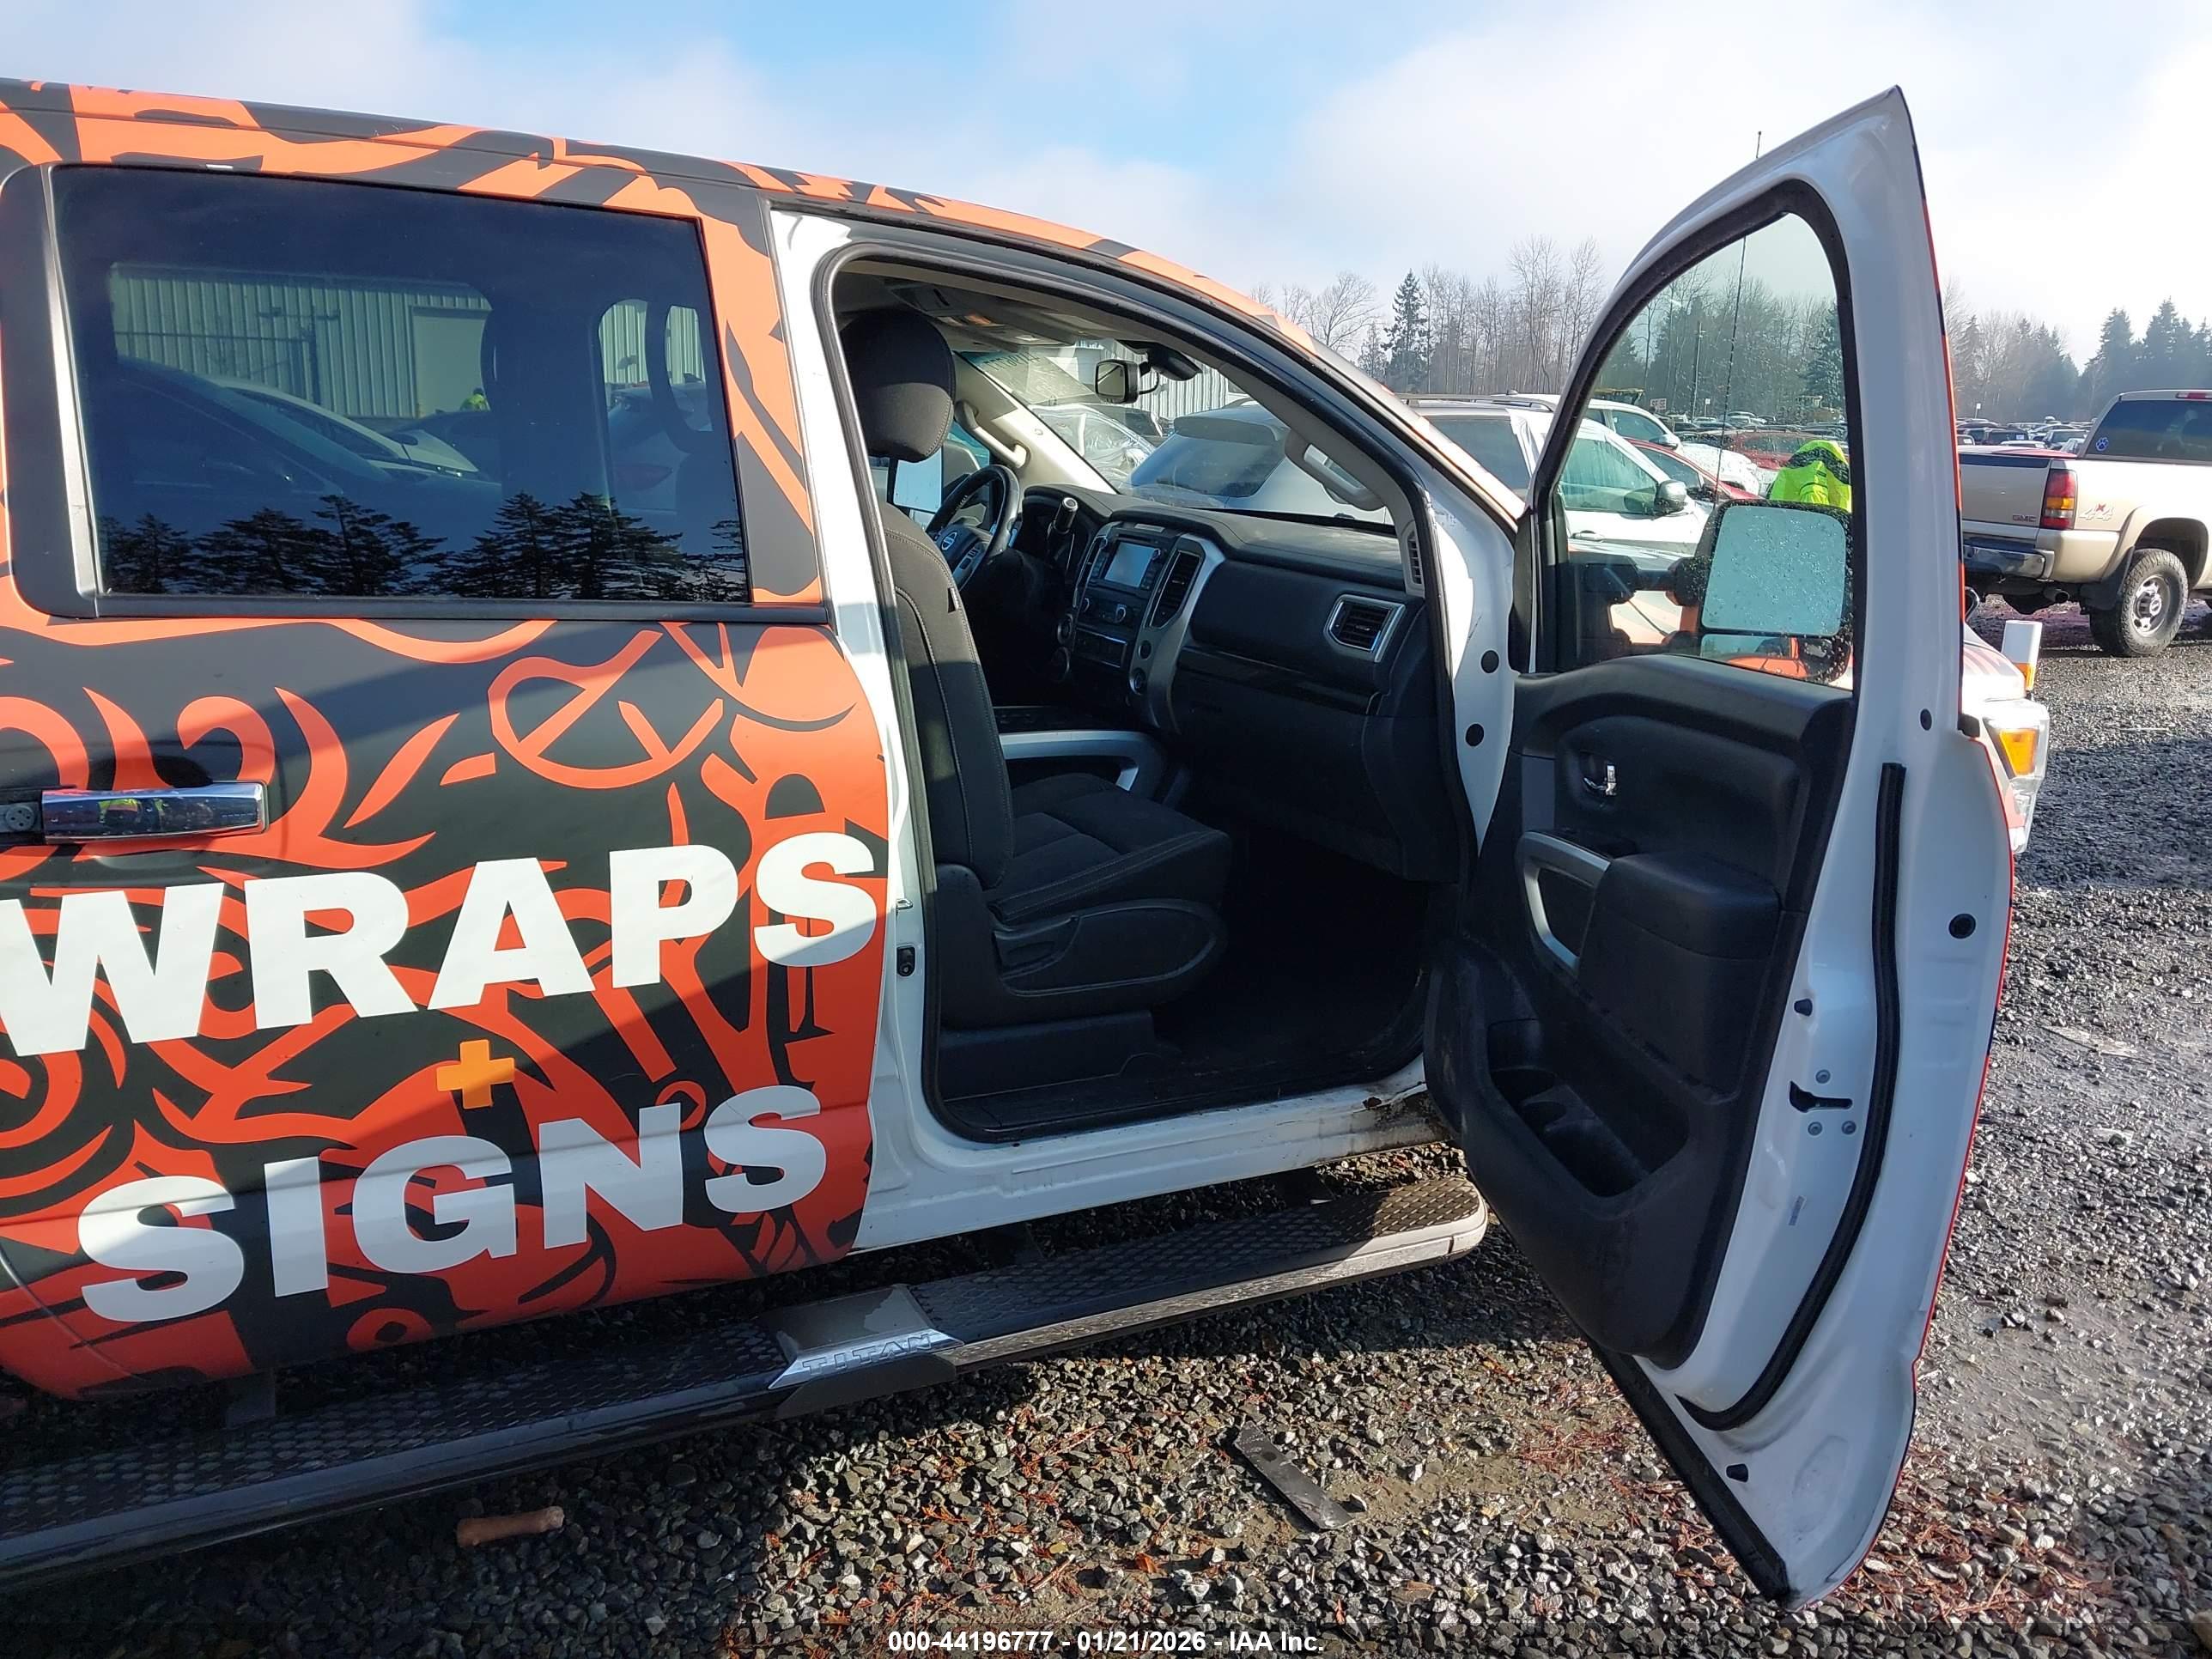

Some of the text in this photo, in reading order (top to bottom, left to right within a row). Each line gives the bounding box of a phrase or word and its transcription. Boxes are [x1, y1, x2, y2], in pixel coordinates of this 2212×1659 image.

[2012, 514, 2037, 523] GMC
[0, 832, 877, 1057] WRAPS
[77, 1085, 827, 1322] SIGNS
[802, 1333, 933, 1376] TITAN
